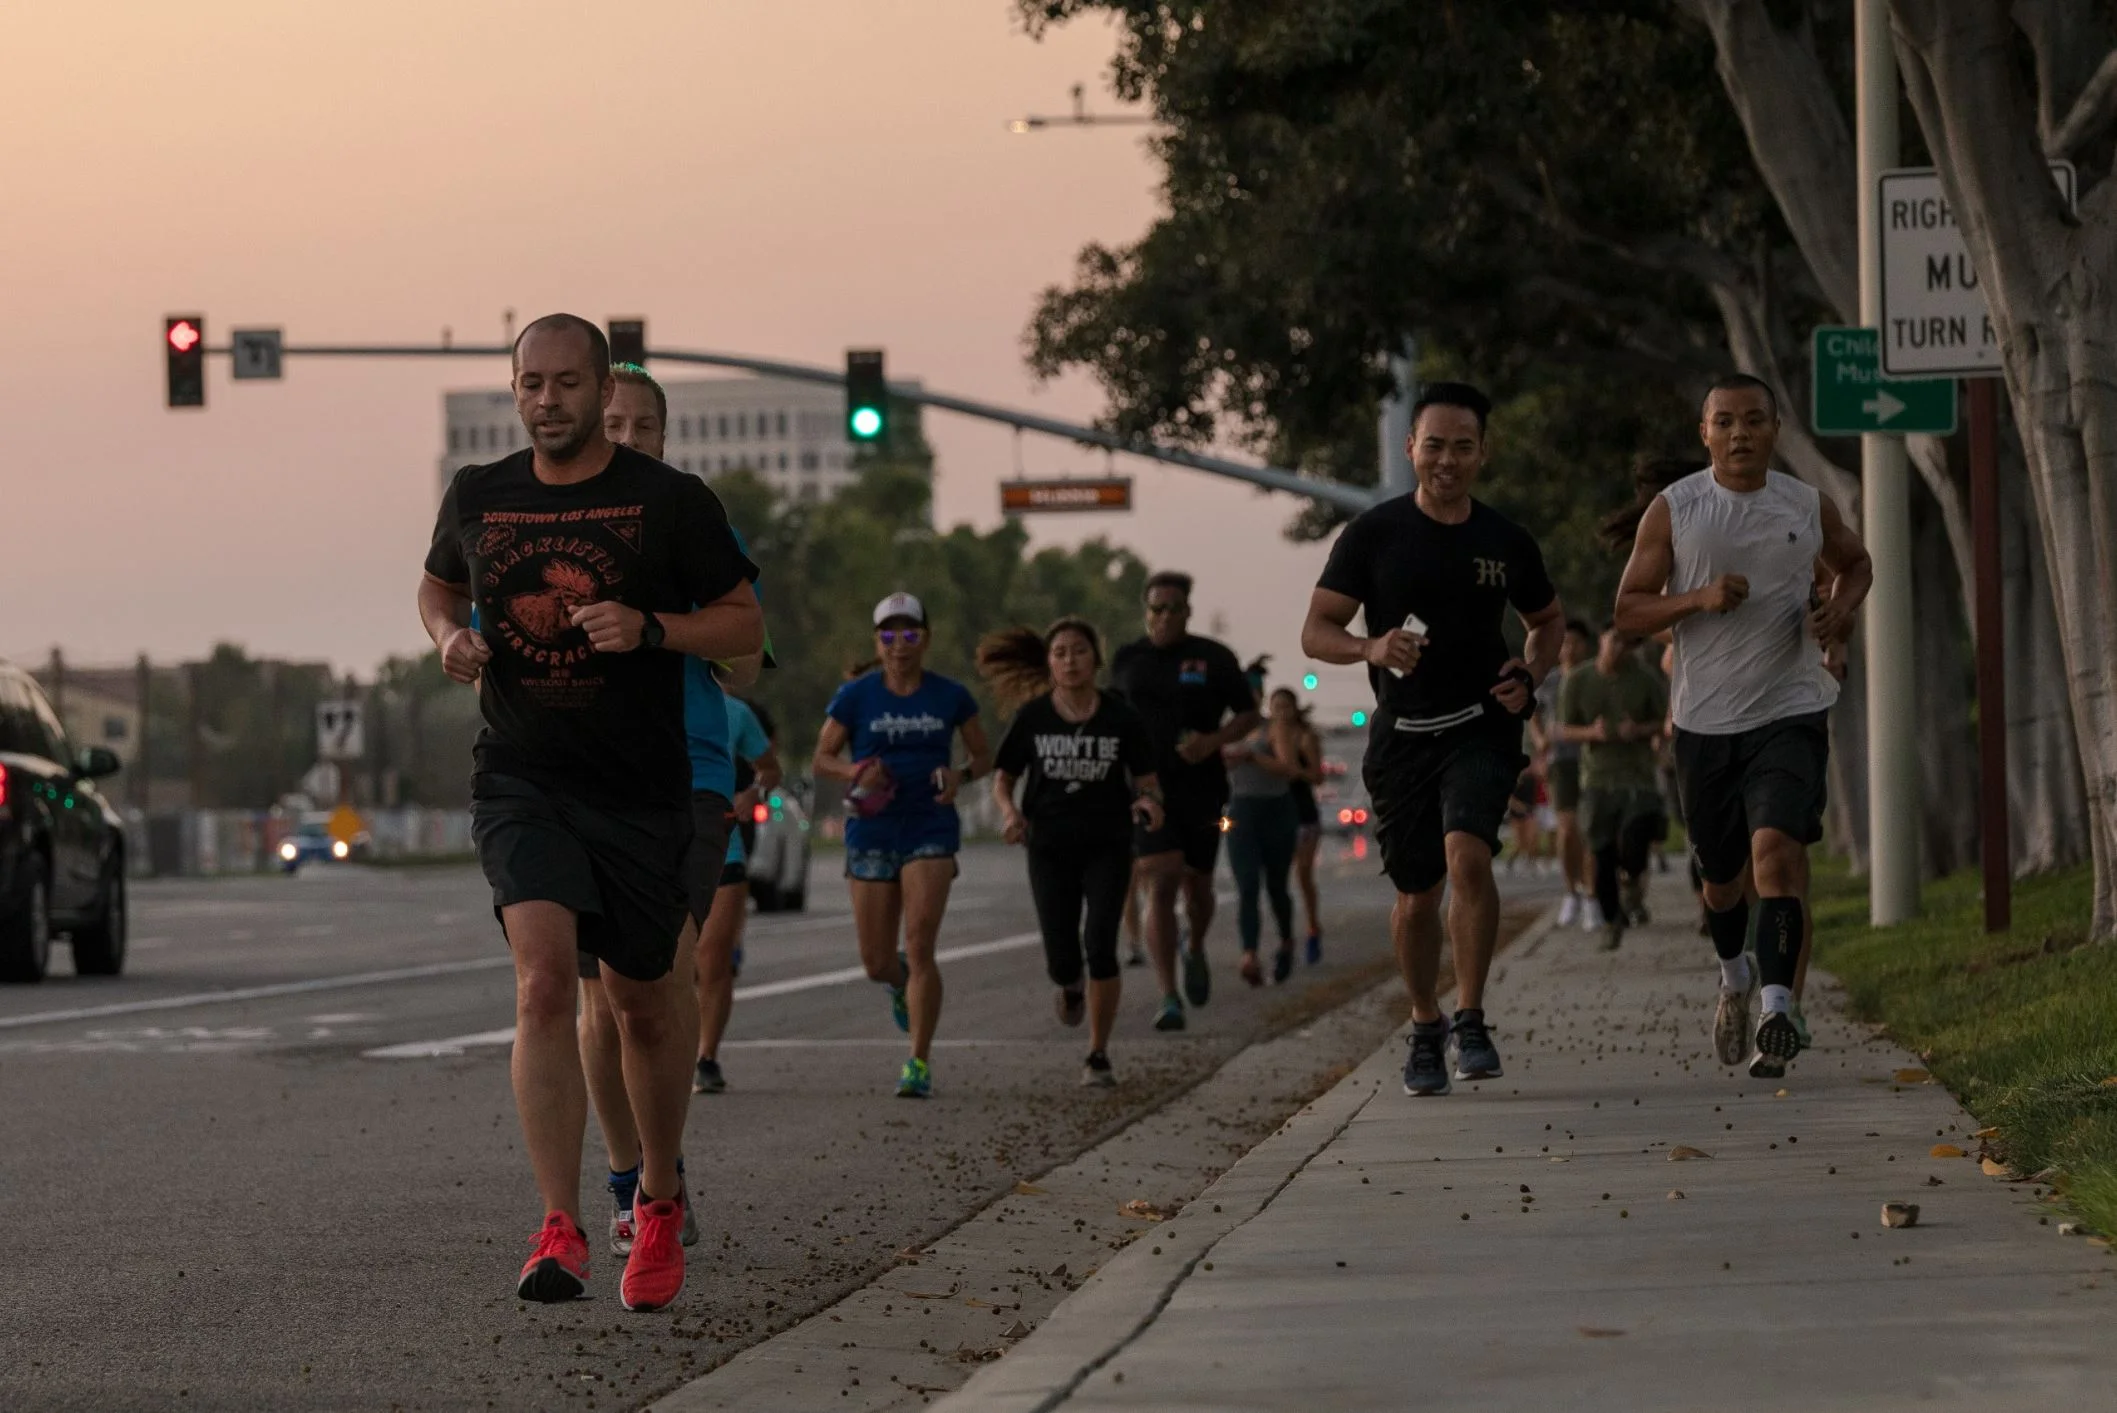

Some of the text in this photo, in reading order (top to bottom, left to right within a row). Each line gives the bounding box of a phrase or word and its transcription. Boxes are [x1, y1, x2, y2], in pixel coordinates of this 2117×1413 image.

[1893, 199, 1955, 229] RIGH
[1927, 255, 1976, 290] MU
[1893, 317, 1966, 347] TURN
[482, 505, 643, 524] DOWNTOWN LOS ANGELES
[497, 621, 596, 665] FIRECRAC
[1034, 734, 1120, 760] WON'T BE
[1043, 758, 1112, 781] CAUGHT
